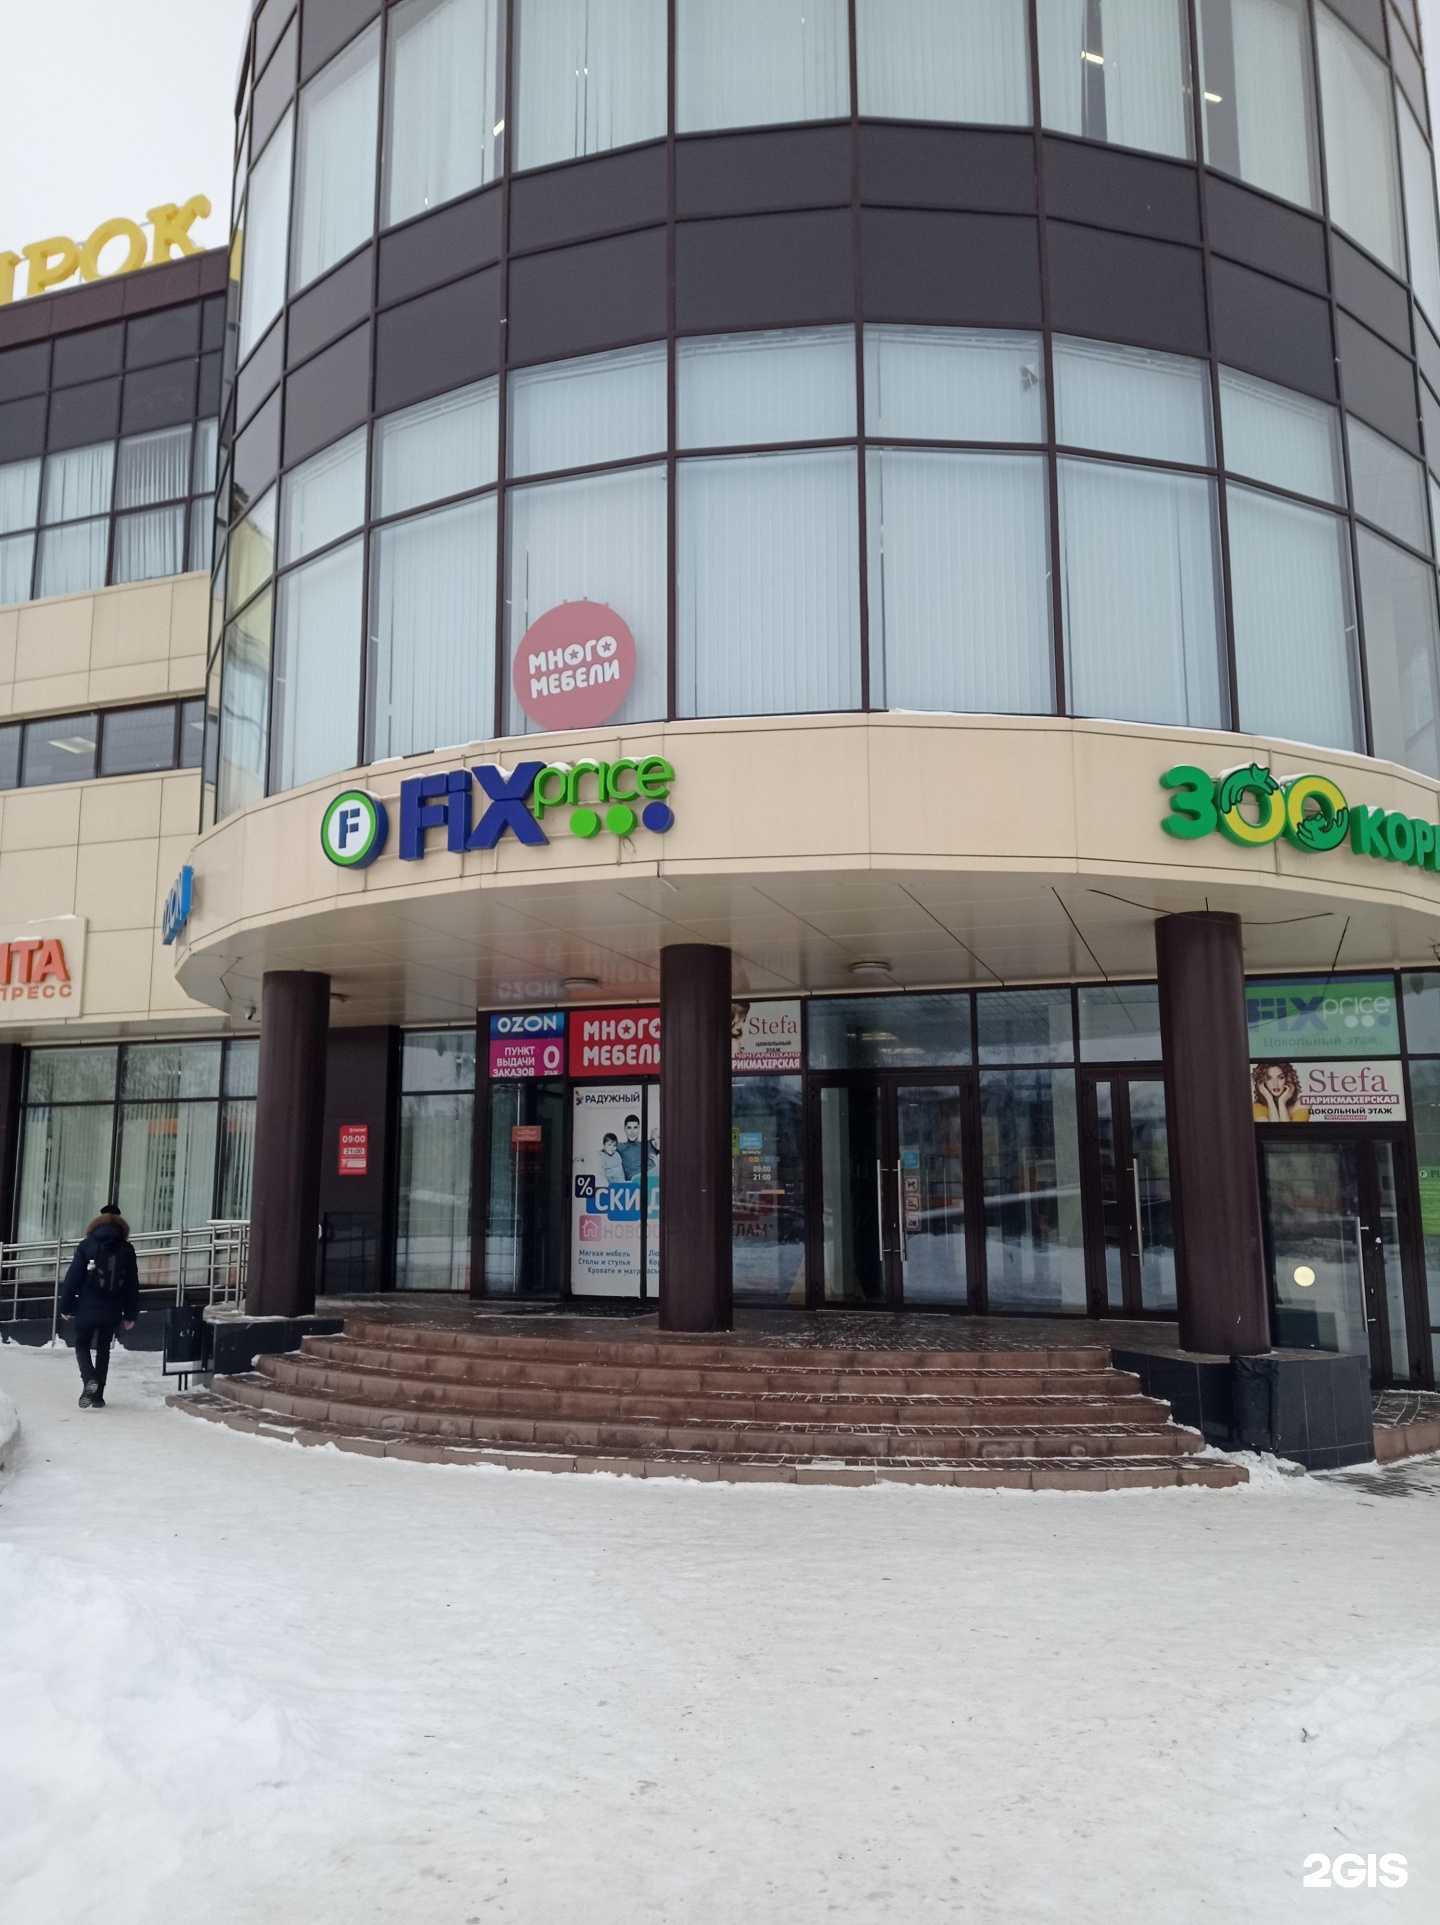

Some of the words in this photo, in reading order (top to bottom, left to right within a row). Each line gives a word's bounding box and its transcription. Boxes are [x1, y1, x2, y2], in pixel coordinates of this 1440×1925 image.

[529, 636, 617, 674] МНОГО
[530, 659, 620, 698] МЕБЕЛИ
[533, 756, 675, 819] price
[1322, 996, 1391, 1020] price
[497, 1015, 557, 1033] OZON
[748, 1015, 798, 1035] Stefa
[505, 1046, 535, 1056] ПУНКТ
[496, 1056, 535, 1067] ВЫДАЧИ
[492, 1067, 535, 1078] ЗАКАЗОВ
[1308, 1067, 1388, 1093] Stefa
[584, 1092, 640, 1104] РАДУЖНЫЙ
[1302, 1095, 1398, 1105] ПАРИКМАХЕРСКАЯ
